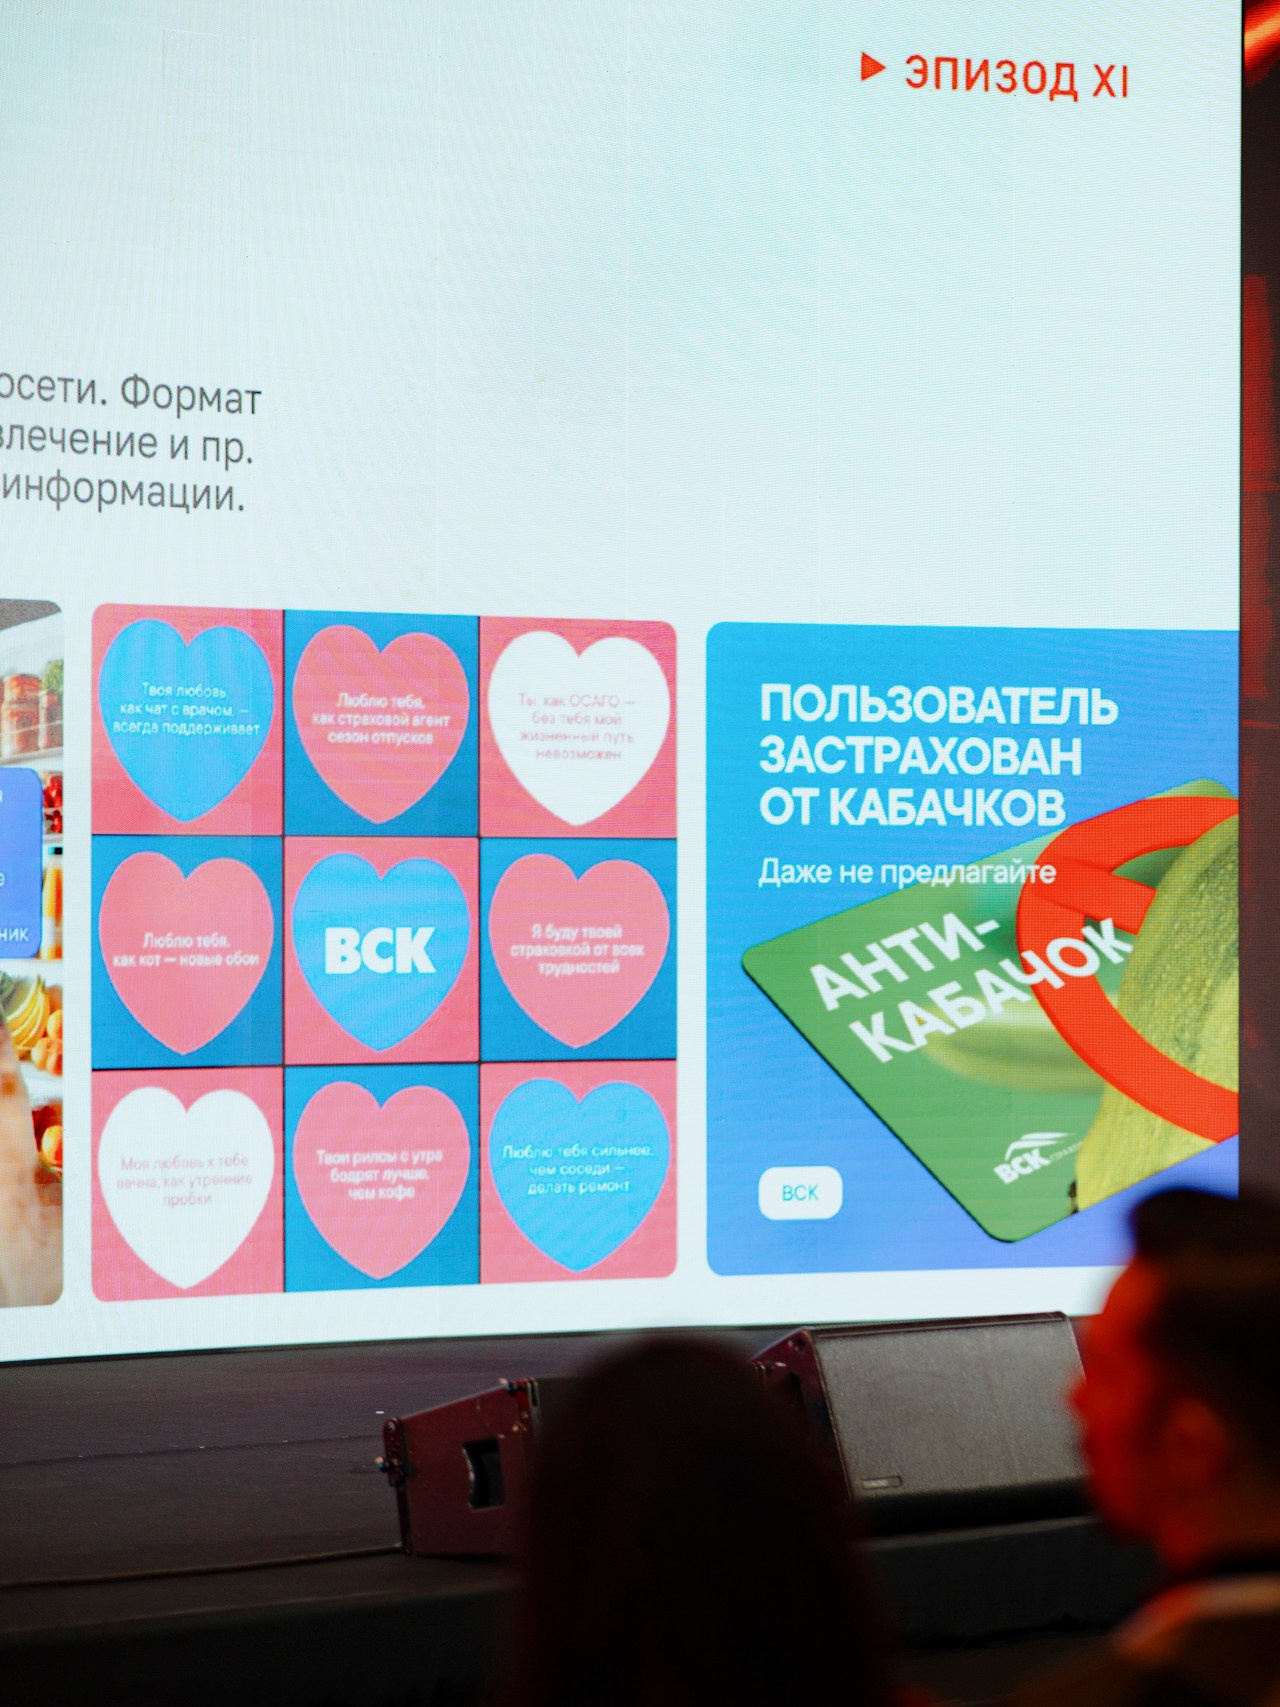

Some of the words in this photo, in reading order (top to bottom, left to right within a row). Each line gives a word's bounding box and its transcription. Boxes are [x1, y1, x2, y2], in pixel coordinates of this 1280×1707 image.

[905, 54, 1078, 102] ЭПИЗОД
[1092, 64, 1128, 98] XI
[121, 373, 262, 418] Формат
[0, 423, 157, 459] лечение
[170, 434, 188, 460] и
[203, 436, 253, 471] пр.
[2, 468, 244, 514] информации.
[142, 682, 172, 696] Твоя
[337, 692, 388, 708] Люблю
[544, 697, 566, 707] как
[569, 694, 620, 708] ОСАГО
[760, 683, 1119, 726] ПОЛЬЗОВАТЕЛЬ
[120, 704, 142, 715] как
[145, 704, 167, 715] чат
[171, 705, 179, 715] с
[531, 711, 556, 724] без
[560, 711, 591, 725] тебя
[595, 711, 622, 725] мой
[312, 713, 335, 725] как
[338, 711, 409, 727] страховой
[412, 715, 450, 727] агент
[113, 721, 158, 735] всегда
[162, 722, 260, 736] поддерживает
[520, 730, 600, 742] жизненный
[604, 732, 634, 744] путь
[328, 731, 369, 743] сезон
[371, 732, 433, 746] отпусков
[536, 749, 622, 760] невозможен
[760, 735, 1083, 776] ЗАСТРАХОВАН
[760, 787, 819, 826] ОТ
[831, 788, 1066, 826] КАБАЧКОВ
[758, 857, 832, 888] Даже
[840, 862, 873, 884] не
[881, 858, 1056, 889] предлагайте
[142, 932, 193, 948] Люблю
[532, 924, 542, 939] Я
[545, 923, 579, 942] буду
[582, 924, 622, 939] твоей
[325, 926, 437, 974] ВСК
[511, 942, 590, 959] страховкой
[593, 944, 609, 956] от
[612, 944, 645, 956] всех
[113, 955, 136, 967] как
[139, 954, 161, 966] кот
[179, 954, 222, 966] новые
[226, 951, 259, 965] обои
[808, 912, 1000, 1011] АНТИ-
[538, 959, 620, 977] трудностей
[848, 917, 1134, 1064] КАБАЧОК
[316, 1149, 350, 1165] Твои
[352, 1152, 397, 1167] рилсы
[400, 1151, 409, 1163] с
[412, 1150, 443, 1165] утра
[503, 1145, 553, 1159] Люблю
[559, 1144, 588, 1157] тебя
[121, 1157, 150, 1170] Моя
[153, 1155, 204, 1170] любовь
[219, 1153, 248, 1167] тебе
[529, 1165, 556, 1176] чем
[560, 1164, 610, 1176] соседи
[993, 1147, 1052, 1185] ВСК
[163, 1177, 185, 1188] как
[189, 1174, 253, 1189] утренние
[330, 1168, 378, 1184] бодрят
[348, 1188, 376, 1199] чем
[379, 1184, 415, 1202] кофе
[528, 1182, 575, 1195] делать
[579, 1181, 630, 1195] ремонт
[782, 1184, 819, 1202] ВСК
[162, 1191, 212, 1208] пробки
